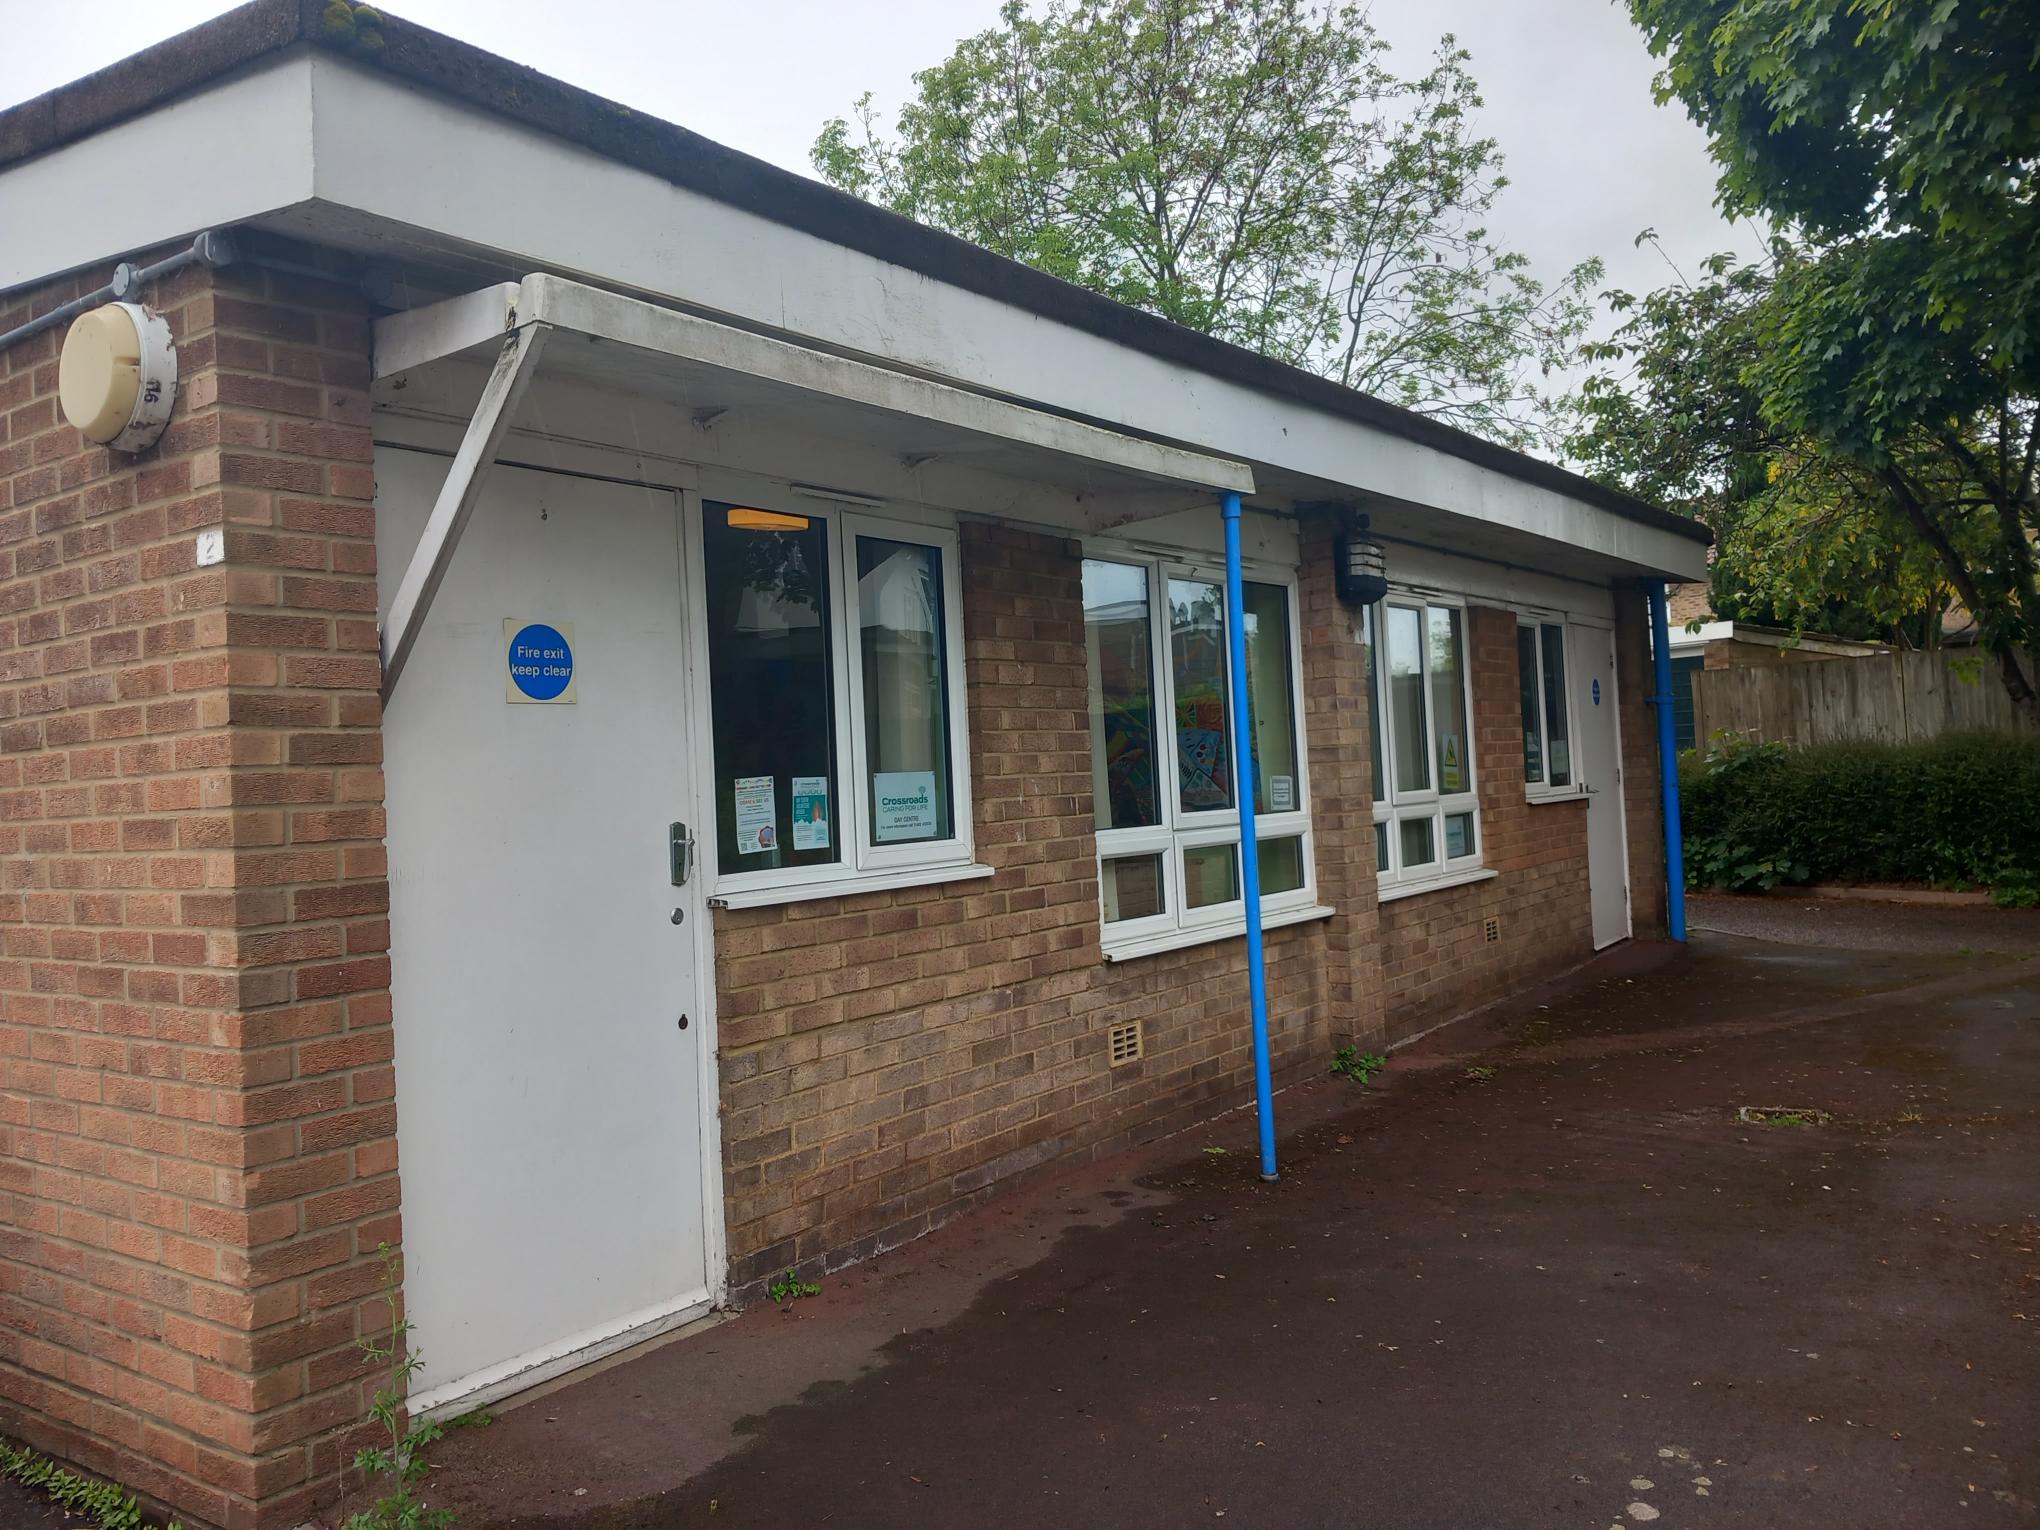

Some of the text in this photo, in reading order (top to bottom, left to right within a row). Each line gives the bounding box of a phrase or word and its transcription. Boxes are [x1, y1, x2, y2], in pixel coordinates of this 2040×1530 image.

[517, 646, 564, 659] Fire exit
[511, 663, 571, 678] keep clear
[882, 794, 928, 805] Crossroads
[882, 805, 904, 813] CARING
